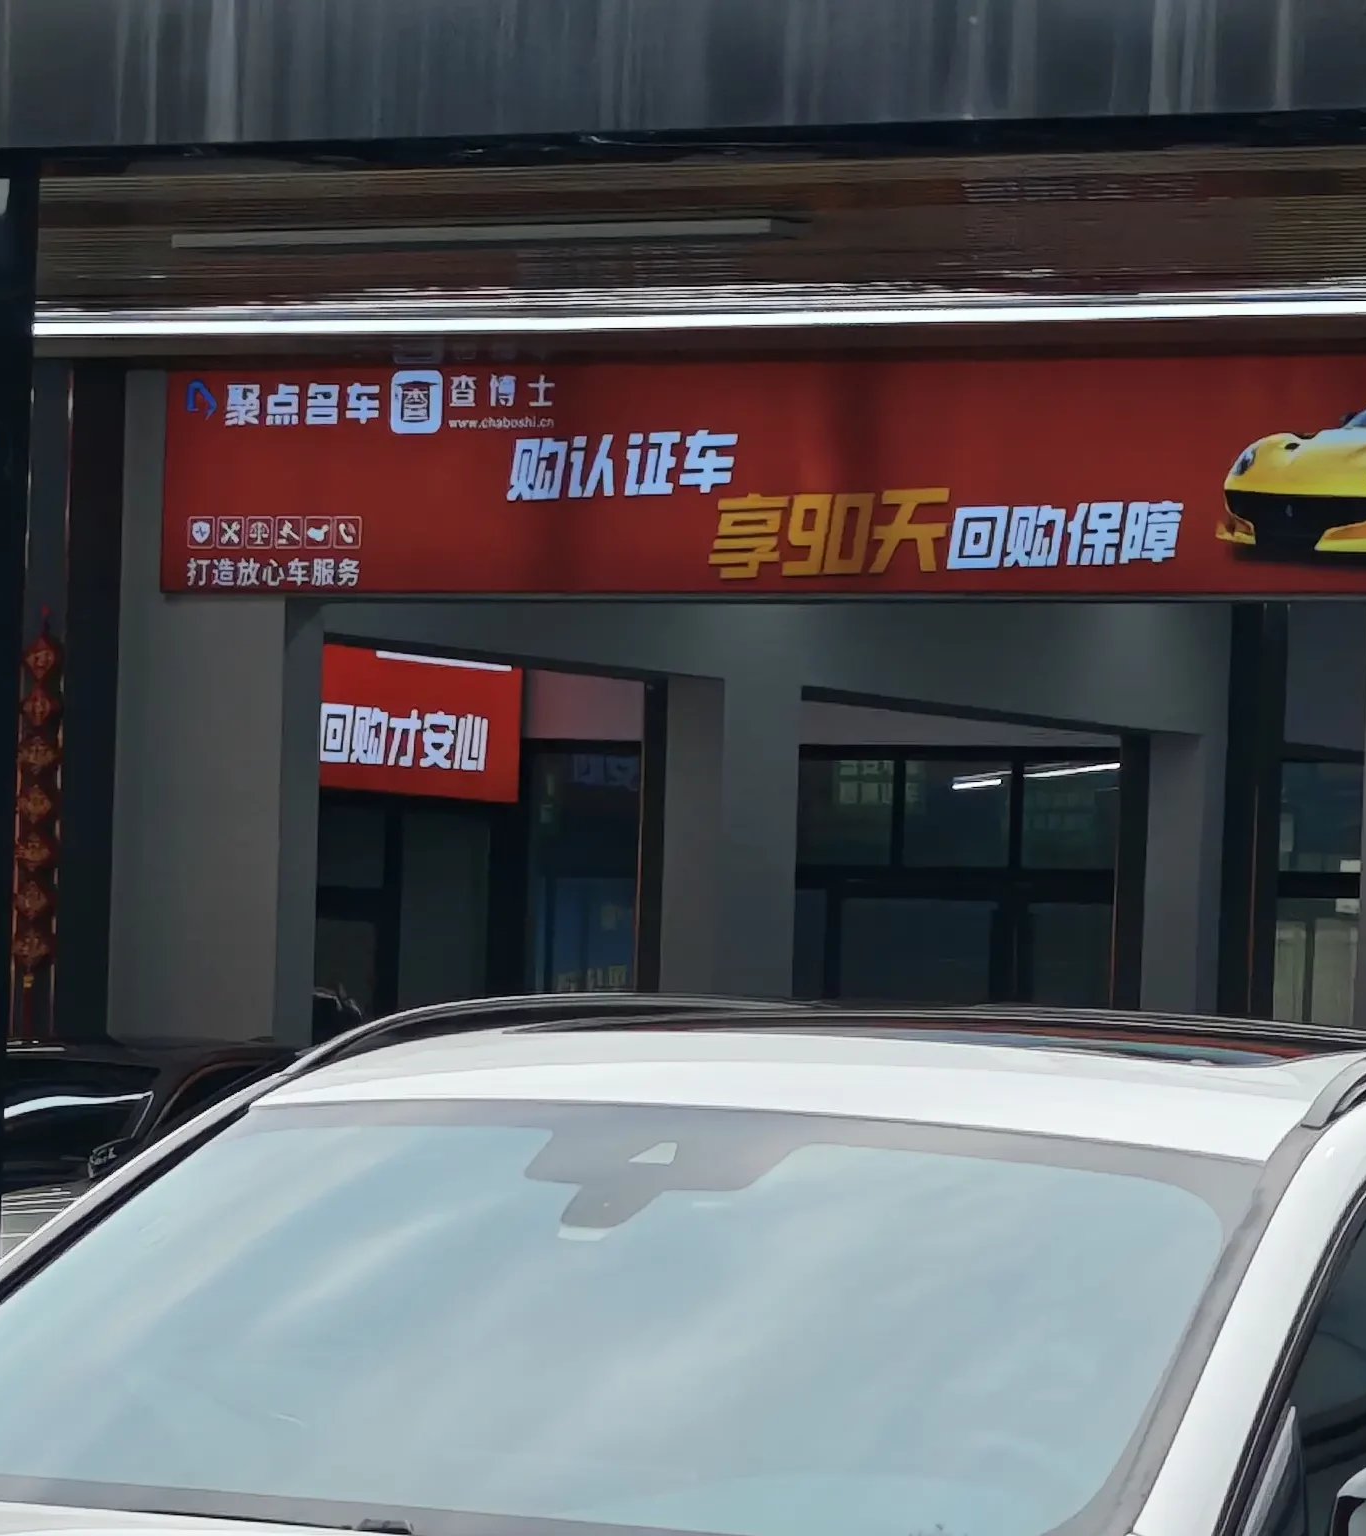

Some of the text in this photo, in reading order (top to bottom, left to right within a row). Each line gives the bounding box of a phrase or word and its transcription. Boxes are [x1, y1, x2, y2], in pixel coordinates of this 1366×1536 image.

[224, 383, 381, 426] 聚点名车
[448, 374, 556, 407] 查博士
[447, 416, 556, 430] www.chaboshi.cn
[506, 430, 738, 501] 购认证车
[186, 557, 361, 587] 打造放心车服务
[319, 703, 489, 771] 回购才安心
